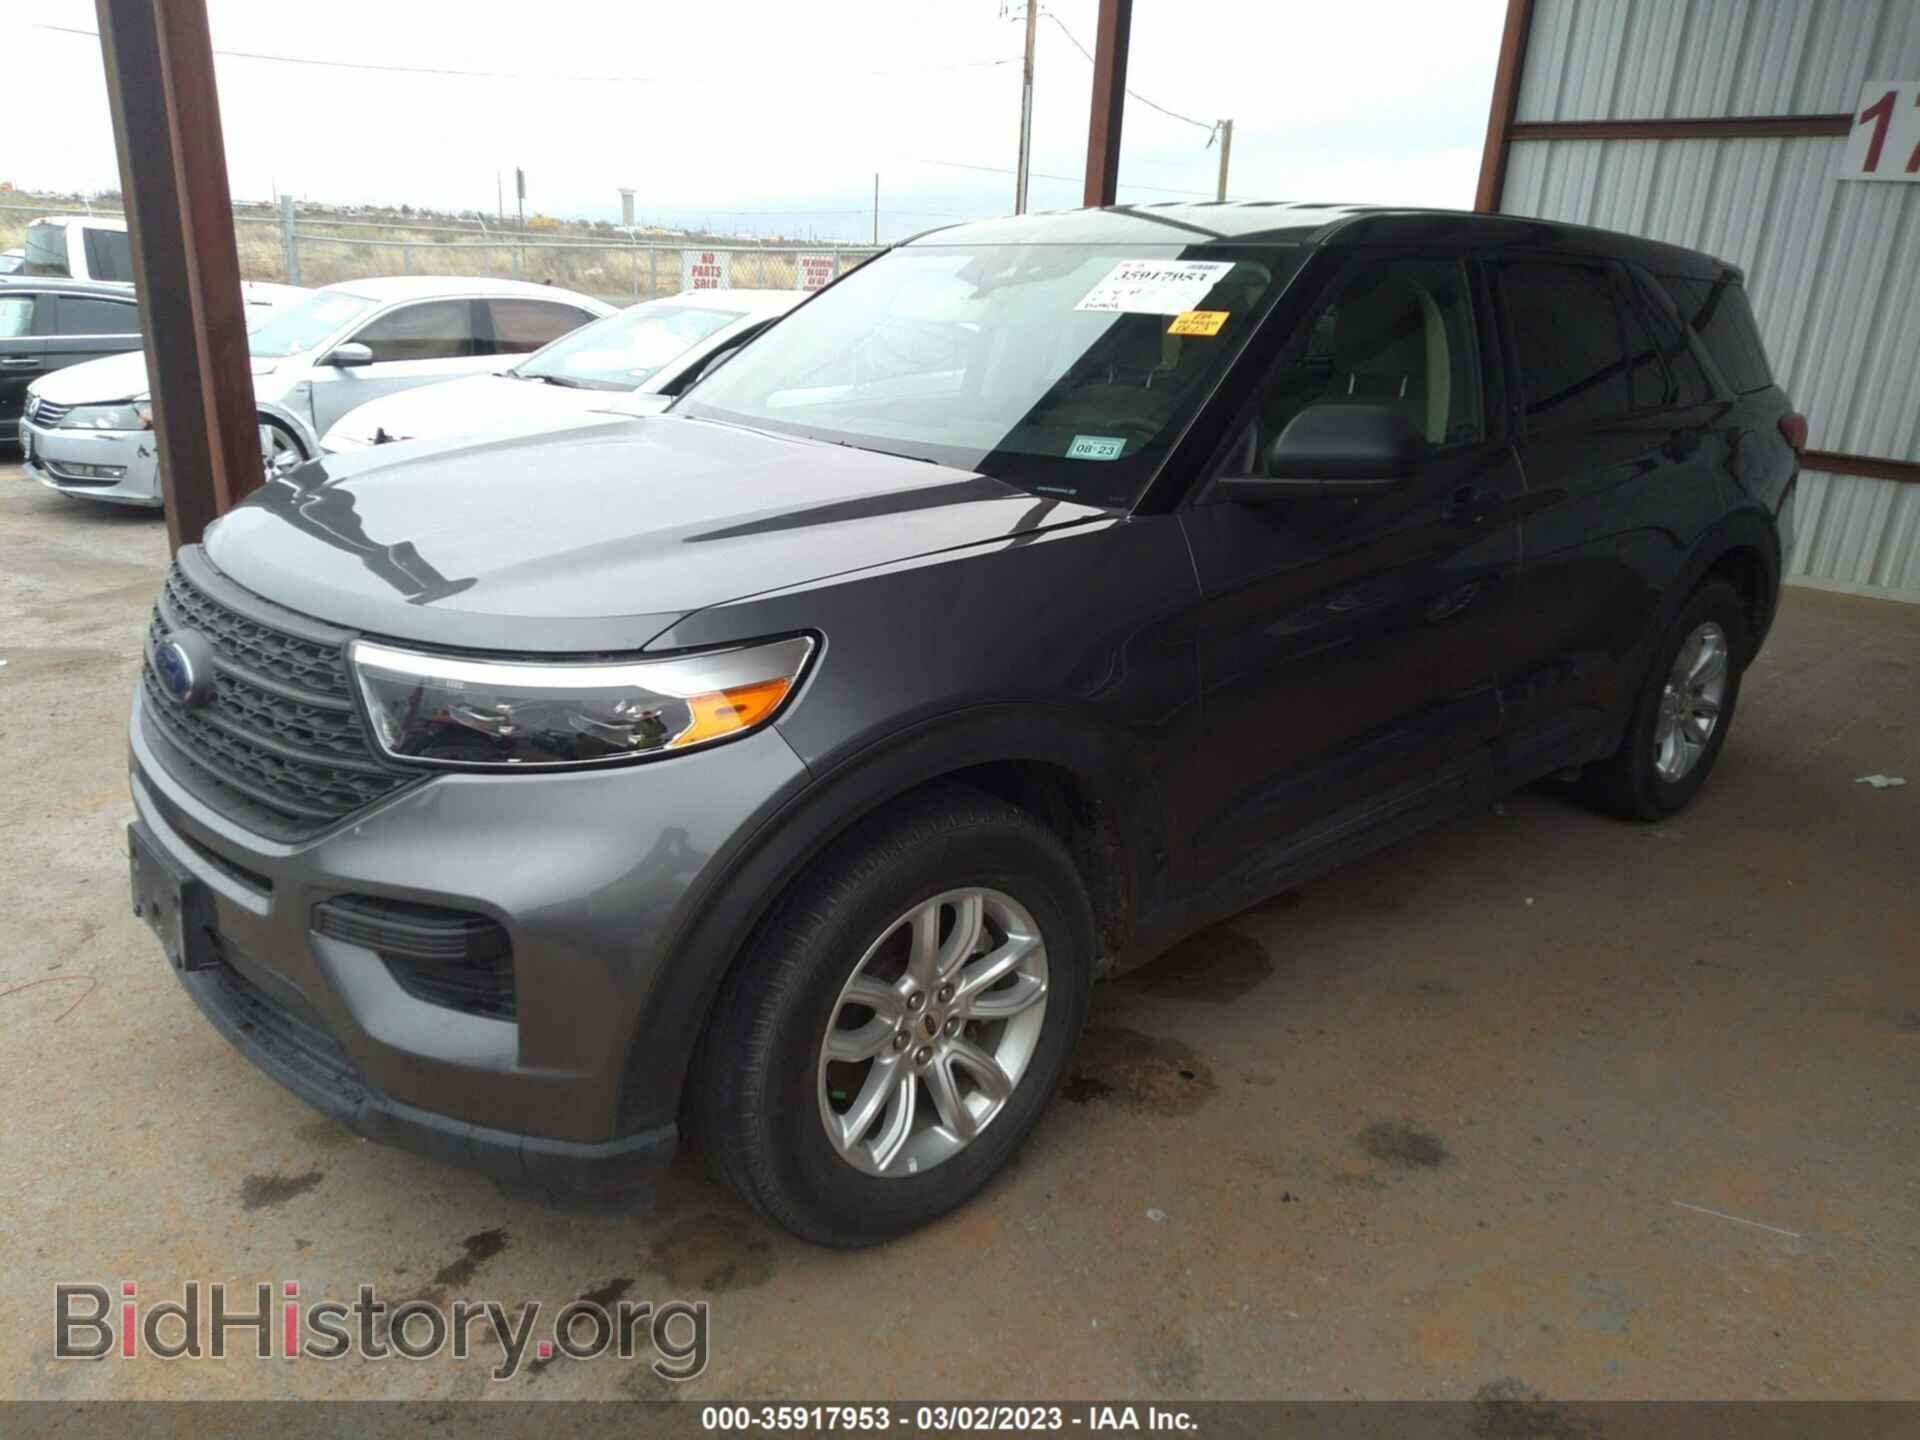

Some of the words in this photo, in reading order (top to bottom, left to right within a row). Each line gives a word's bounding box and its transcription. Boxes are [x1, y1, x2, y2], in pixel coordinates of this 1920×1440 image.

[702, 253, 715, 264] NO
[692, 265, 721, 277] PARTS
[694, 278, 718, 289] SOLD
